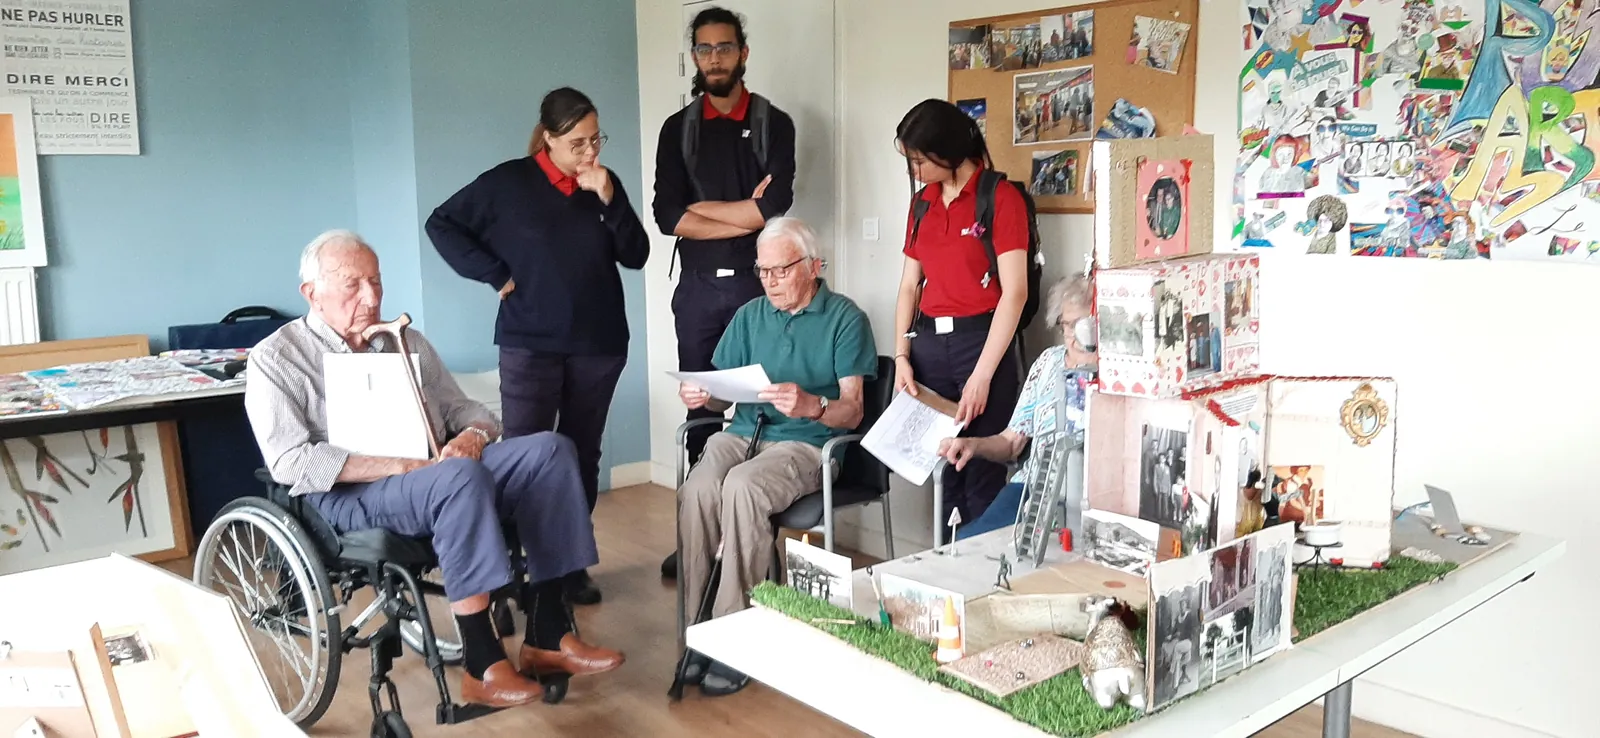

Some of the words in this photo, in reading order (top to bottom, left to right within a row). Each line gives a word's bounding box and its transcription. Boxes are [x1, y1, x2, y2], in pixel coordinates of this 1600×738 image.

[1, 8, 24, 22] NE
[28, 9, 58, 23] PAS
[62, 11, 125, 27] HURLER
[6, 73, 55, 85] DIRE
[65, 75, 129, 87] MERCI
[90, 112, 131, 124] DIRE
